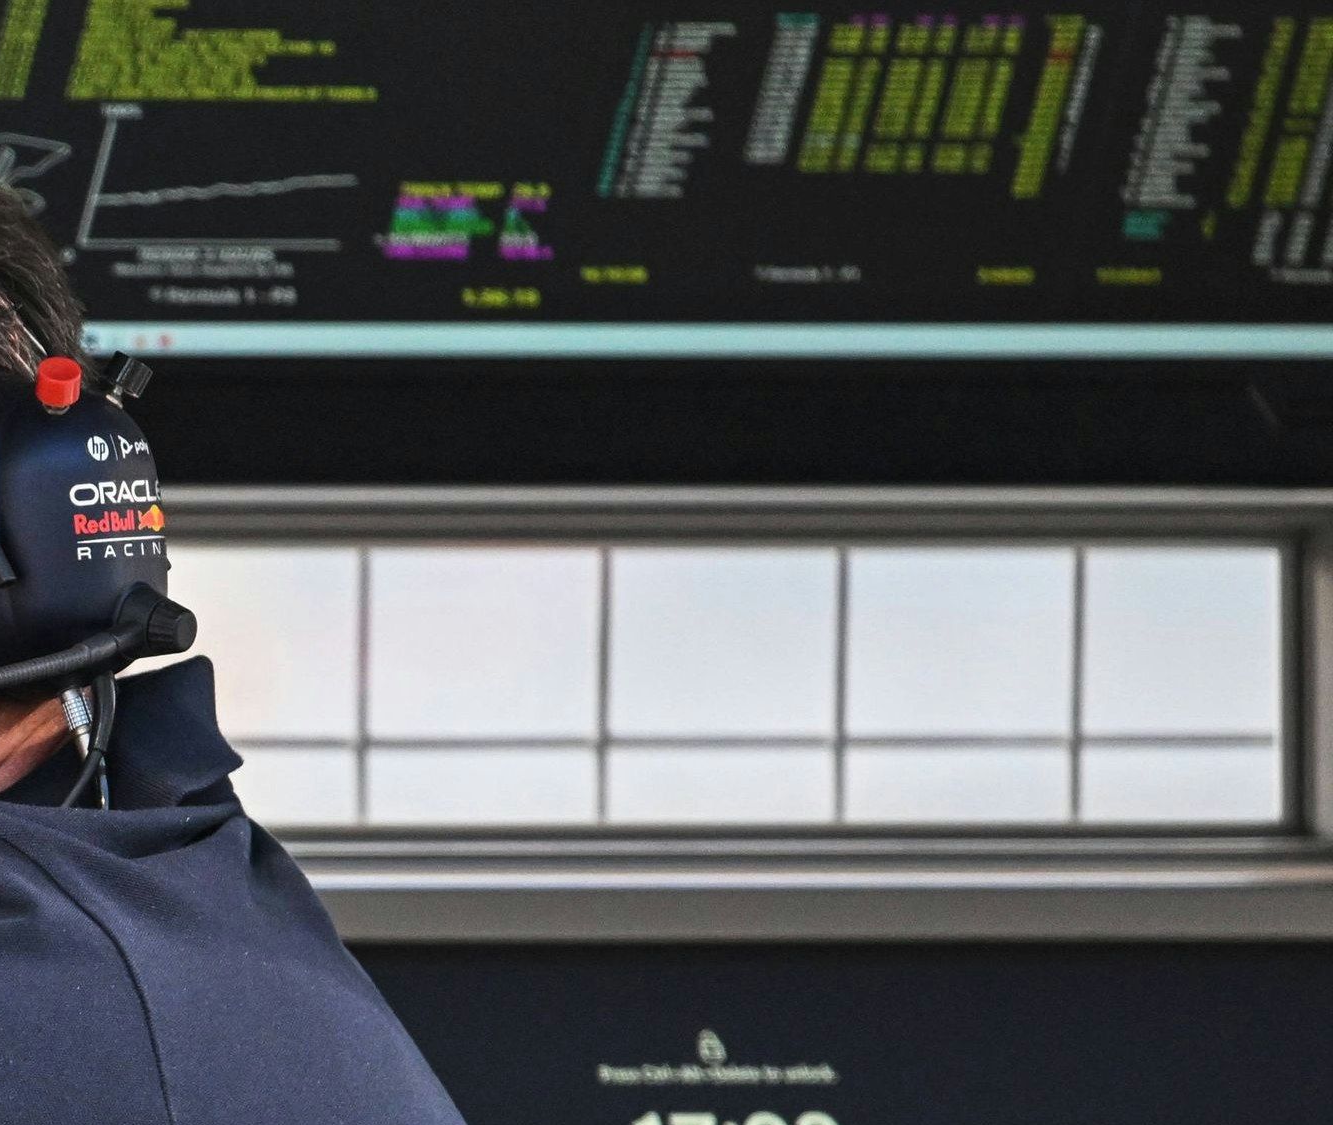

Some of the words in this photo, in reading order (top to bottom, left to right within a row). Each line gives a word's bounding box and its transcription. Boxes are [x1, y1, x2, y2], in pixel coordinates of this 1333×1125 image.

[89, 436, 108, 461] hp
[73, 510, 111, 535] Red
[110, 509, 135, 532] Bull
[76, 542, 162, 560] RACIN
